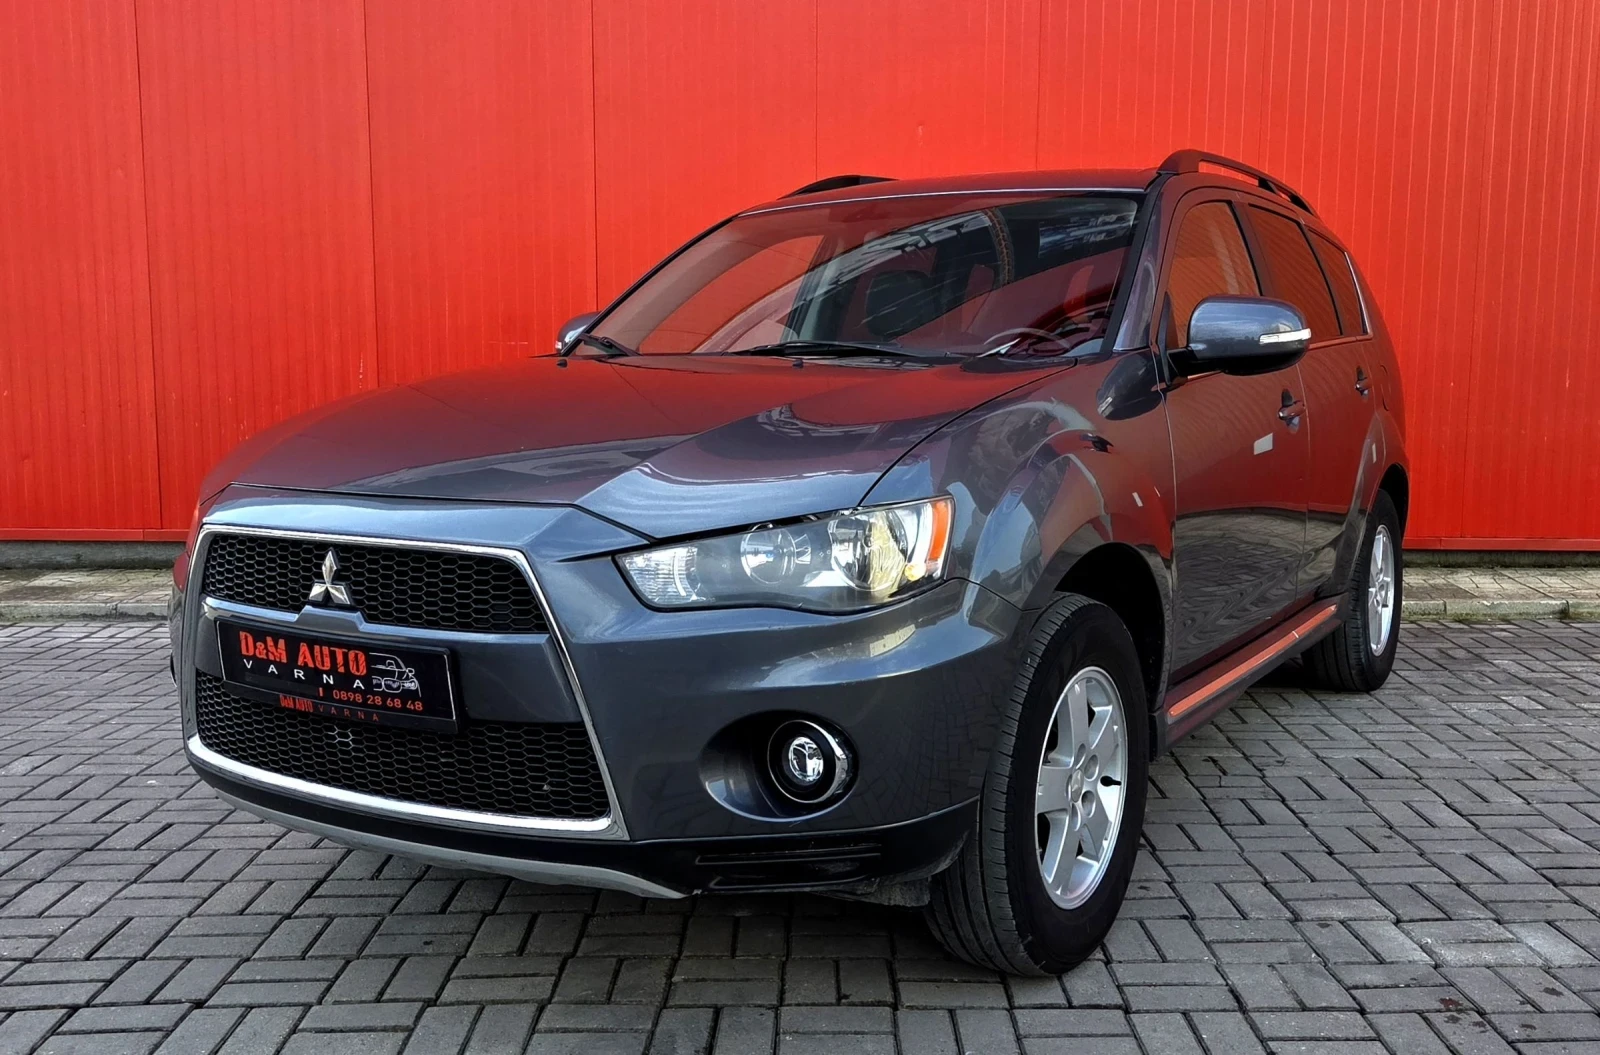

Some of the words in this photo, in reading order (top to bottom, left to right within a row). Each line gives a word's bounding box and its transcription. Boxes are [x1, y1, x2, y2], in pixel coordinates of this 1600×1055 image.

[239, 631, 287, 663] D&M
[297, 642, 367, 676] AUTO
[243, 658, 365, 690] VARNA
[295, 698, 314, 713] AUTO
[318, 705, 379, 722] VARNA
[333, 690, 363, 703] 0898
[367, 694, 382, 706] 28
[387, 697, 402, 709] 68
[406, 700, 423, 712] 48
